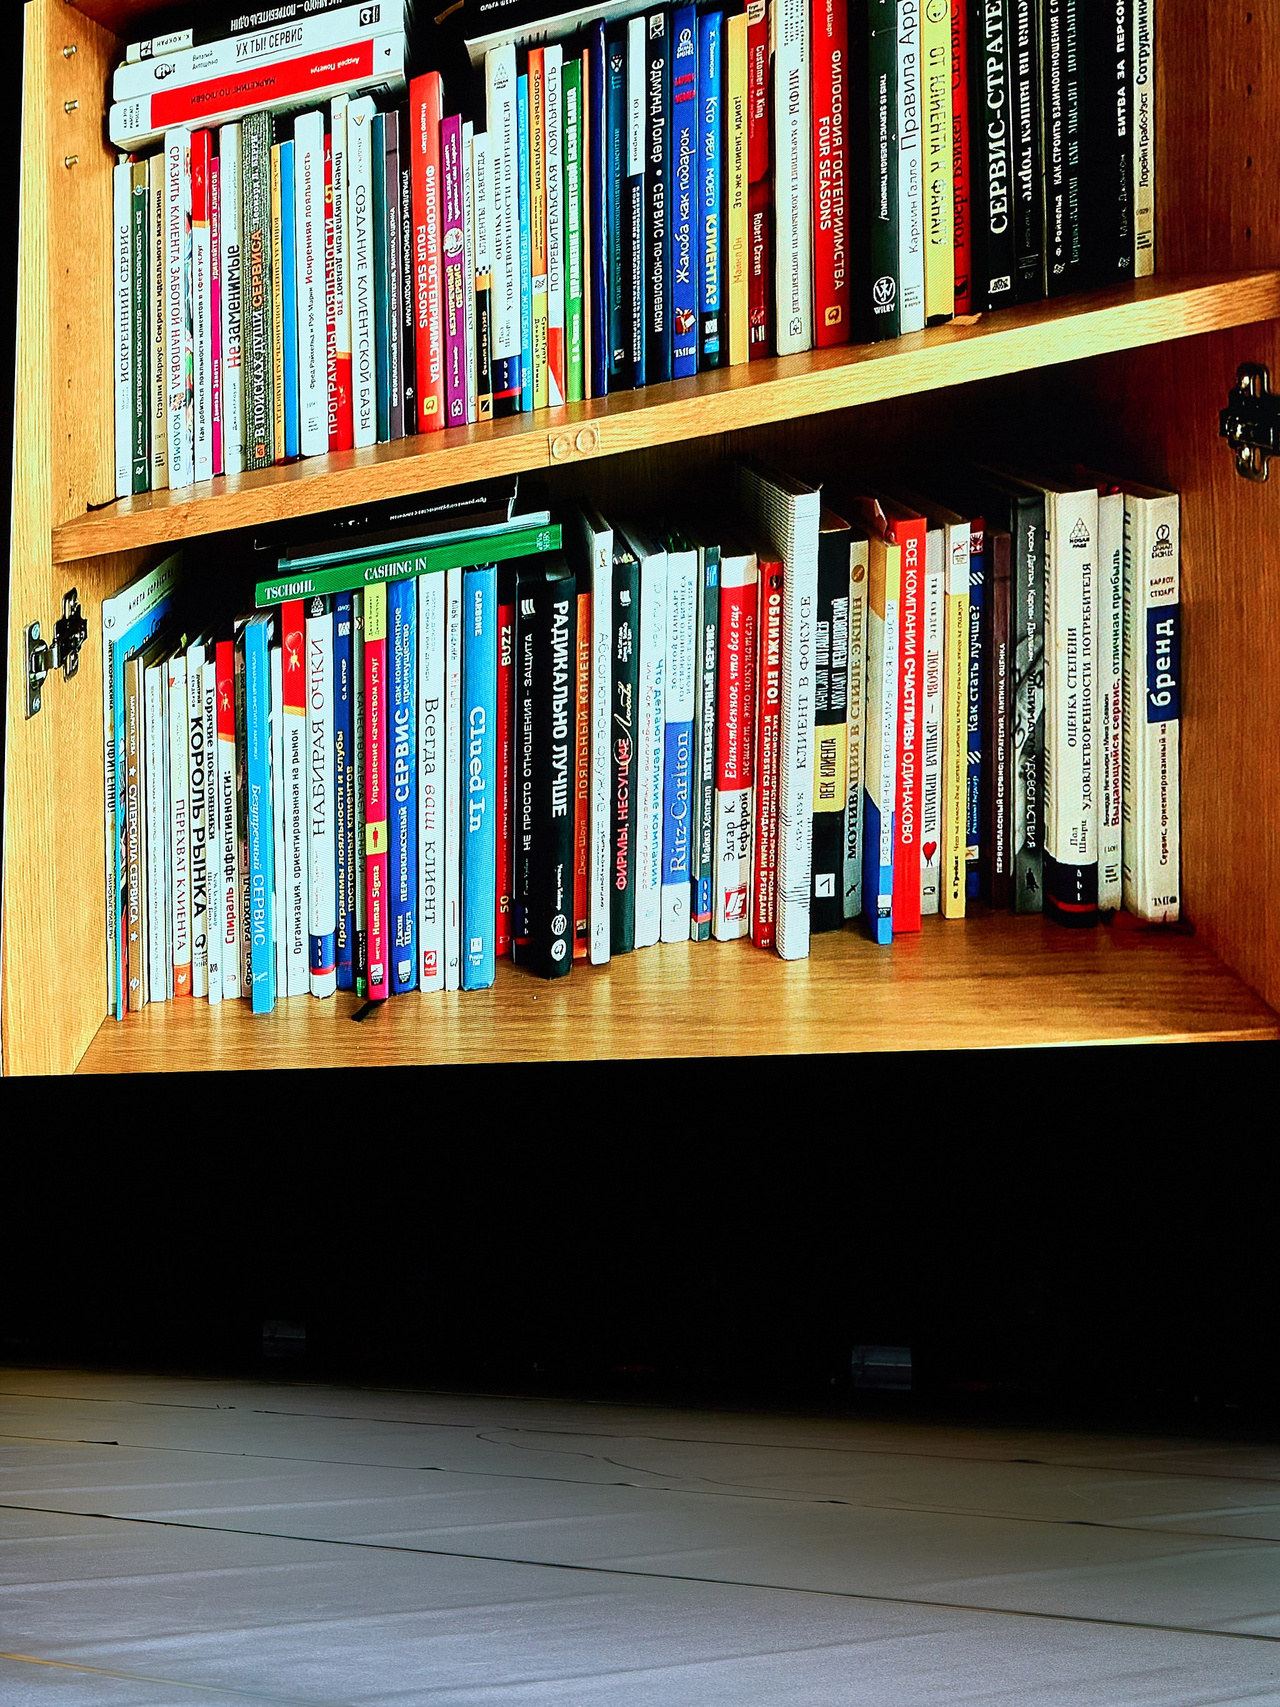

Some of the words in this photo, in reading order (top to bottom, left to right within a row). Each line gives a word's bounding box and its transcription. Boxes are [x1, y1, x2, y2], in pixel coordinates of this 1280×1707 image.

[236, 43, 249, 56] УХ
[250, 39, 267, 53] ТЫ!
[269, 27, 303, 48] СЕРВИС
[756, 45, 765, 85] Customer
[1051, 16, 1061, 118] ВЗАИМООТНОШЕНИЯ
[532, 69, 542, 126] «Золотые»
[548, 66, 558, 156] ЛОЯЛЬНОСТЬ
[650, 57, 665, 114] Эдмунд
[705, 97, 717, 123] Кто
[756, 98, 766, 118] King
[832, 50, 842, 146] ФИЛОСОФИЯ
[900, 53, 919, 150] Правила
[1117, 86, 1126, 136] БИТВА
[504, 100, 512, 182] ПОТРЕБИТЕЛЯ
[532, 128, 542, 190] покупатели
[651, 118, 665, 163] Лопер
[676, 127, 696, 191] подарок
[705, 131, 715, 160] увел
[819, 116, 830, 155] FOUR
[1052, 120, 1062, 163] СТРОИТЬ
[170, 146, 180, 202] СРАЗИТЬ
[334, 151, 344, 190] Почему
[705, 168, 716, 206] моего
[819, 160, 831, 230] SEASONS
[1053, 161, 1063, 185] КАК
[170, 205, 180, 264] КЛИЕНТА
[335, 193, 344, 254] покупатели
[356, 184, 367, 270] СОЗДАНИЕ
[425, 165, 437, 251] ФИЛОСОФИЯ
[495, 213, 503, 260] ОЦЕНКА
[548, 164, 559, 292] ПОТРЕБИТЕЛЬСКАЯ
[655, 182, 665, 238] СЕРВИС
[679, 193, 690, 220] как
[754, 212, 762, 241] Robert
[833, 150, 844, 290] ГОСТЕПРИИМСТВА
[119, 224, 129, 283] СЕРВИС
[155, 239, 164, 297] идеального
[251, 229, 263, 308] СЕРВИСА
[325, 217, 336, 327] ЛОЯЛЬНОСТИ
[416, 225, 426, 261] FOUR
[504, 186, 514, 311] УДОВЛЕТВОРЕННОСТИ
[674, 223, 690, 284] Жалоба
[705, 213, 717, 304] КЛИЕНТА?
[754, 245, 763, 276] Craven
[170, 267, 183, 326] ЗАБОТОЙ
[335, 257, 344, 295] делают
[418, 265, 428, 329] SEASONS
[454, 263, 463, 309] СЕРВИС
[654, 241, 664, 333] по-королевски
[118, 287, 129, 383] ИСКРЕННИЙ
[155, 298, 164, 344] Секреты
[252, 310, 266, 353] ДУШИ
[335, 298, 344, 316] это
[357, 274, 372, 384] КЛИЕНТСКОЙ
[428, 256, 439, 384] ГОСТЕПРИИМСТВА
[874, 303, 896, 315] WILEY
[155, 347, 164, 383] Маркус
[171, 329, 181, 389] НАПОВАЛ
[328, 332, 338, 435] ПРОГРАММЫ
[155, 385, 163, 419] Стэнли
[253, 361, 264, 429] ПОИСКАХ
[361, 387, 370, 429] БАЗЫ
[173, 413, 181, 471] КОЛОМБО
[264, 579, 316, 600] TSCHOHL
[364, 559, 413, 581] CASHING
[415, 557, 428, 572] IN
[906, 536, 918, 569] ВСЕ
[1110, 549, 1122, 609] прибыль
[474, 590, 483, 637] CARBONE
[729, 605, 742, 628] еще
[768, 594, 781, 665] ОБЛИЖИ
[799, 596, 811, 670] ФОКУСЕ
[906, 570, 918, 643] КОМПАНИИ
[969, 605, 982, 658] лучше?
[1082, 563, 1091, 657] ПОТРЕБИТЕЛЯ
[371, 657, 380, 684] услуг
[402, 623, 411, 703] преимущество
[501, 625, 512, 666] BUZZ
[524, 633, 533, 687] ЗАЩИТА
[550, 600, 569, 739] РАДИКАЛЬНО
[727, 632, 739, 651] все
[729, 654, 739, 679] что
[1068, 628, 1077, 689] СТЕПЕНИ
[1112, 613, 1120, 675] отличная
[1149, 618, 1177, 707] бренд
[311, 638, 324, 710] ОЧКИ
[579, 641, 589, 704] КЛИЕНТ
[767, 671, 779, 704] ЕГО!
[799, 677, 809, 687] В
[850, 658, 861, 720] СТИЛЕ
[969, 662, 979, 702] стать
[206, 688, 215, 747] Горячие
[371, 686, 379, 741] качеством
[725, 682, 740, 779] Единственное,
[796, 695, 809, 769] КЛИЕНТ
[903, 658, 916, 750] СЧАСТЛИВЫ
[968, 704, 979, 732] Как
[1067, 693, 1078, 747] ОЦЕНКА
[1111, 678, 1123, 729] сервис,
[291, 729, 300, 764] рынок
[336, 730, 345, 772] клубы
[395, 708, 411, 802] СЕРВИС
[423, 698, 439, 775] Всегда
[469, 706, 486, 793] Clued
[523, 699, 533, 777] ОТНОШЕНИЯ
[577, 711, 589, 799] ЛОЯЛЬНЫЙ
[820, 738, 836, 777] КЛИЕНТА
[1082, 662, 1093, 811] УДОВЛЕТВОРЕННОСТИ
[191, 716, 205, 819] КОРОЛЬ
[206, 751, 216, 840] поклонники
[292, 768, 299, 780] на
[312, 719, 326, 837] НАБИРАЯ
[370, 743, 379, 805] Управление
[552, 744, 569, 818] ЛУЧШЕ
[819, 782, 835, 799] ВЕК
[901, 752, 914, 844] ОДИНАКОВО
[1110, 734, 1121, 826] Выдающийся
[128, 784, 137, 861] СУПЕРСИЛА
[223, 770, 235, 883] эффективности:
[251, 784, 262, 870] Безупречный
[336, 787, 345, 866] лояльности
[424, 785, 435, 830] ваш
[469, 797, 486, 833] In
[523, 782, 532, 830] ПРОСТО
[669, 731, 689, 872] Ritz-Carlton
[724, 801, 735, 814] К.
[737, 792, 751, 860] Геффрой
[847, 741, 860, 859] МОТИВАЦИЯ
[175, 799, 186, 872] ПЕРЕХВАТ
[291, 783, 301, 879] ориентированная
[398, 806, 408, 902] ПЕРВОКЛАССНЫЙ
[523, 835, 531, 851] НЕ
[615, 823, 630, 890] ФИРМЫ,
[723, 821, 737, 862] Эдгар
[130, 864, 138, 924] СЕРВИСА
[193, 826, 206, 918] РЫНКА
[372, 865, 382, 898] Sigma
[424, 840, 435, 924] клиент
[176, 879, 187, 951] КЛИЕНТА
[225, 887, 236, 944] Спираль
[243, 877, 251, 942] РАЙХЕЛЬД
[253, 875, 265, 946] СЕРВИС
[293, 881, 303, 955] Организация,
[338, 869, 347, 948] Программы
[500, 895, 509, 913] 50
